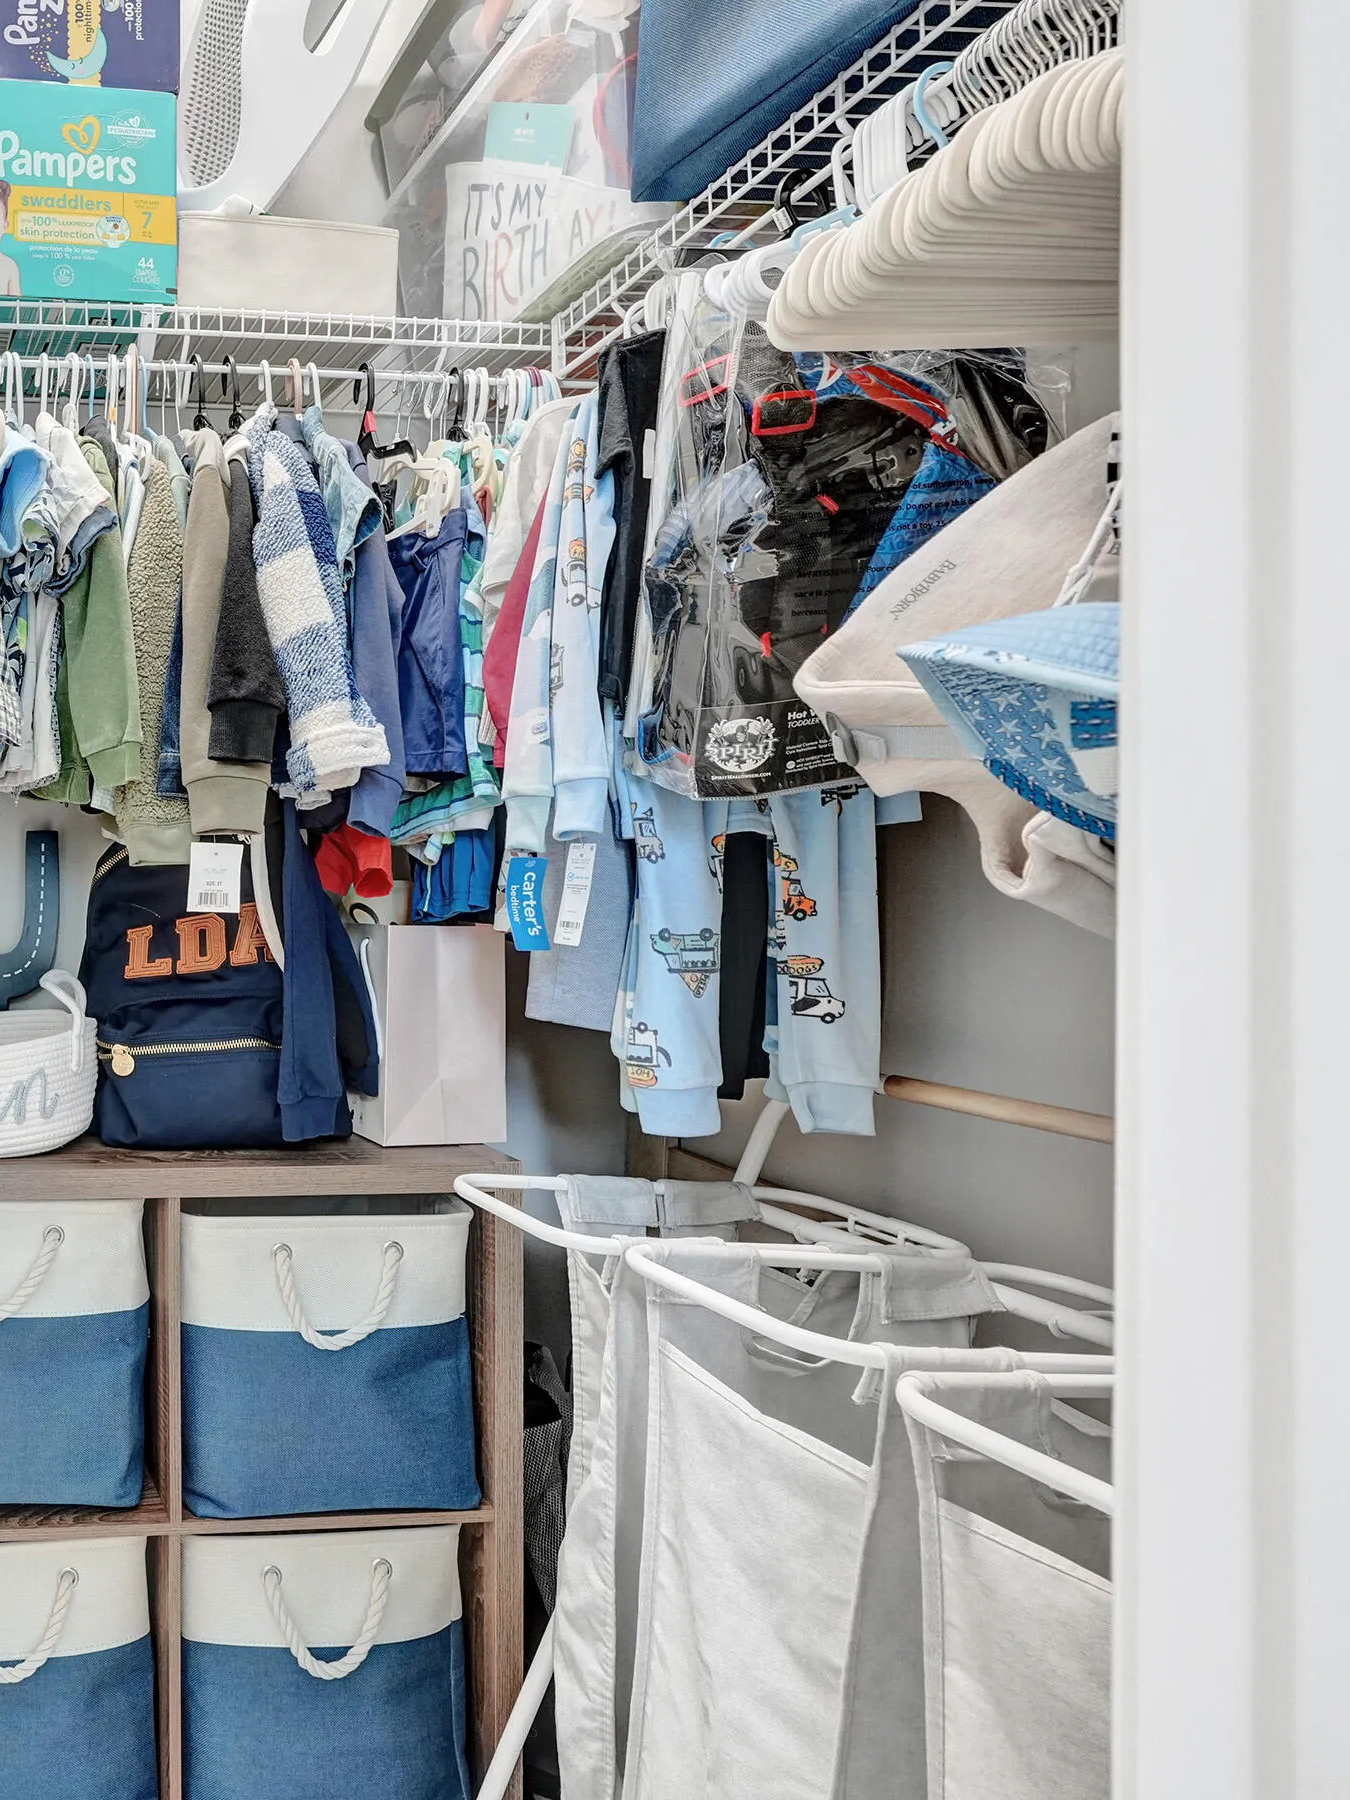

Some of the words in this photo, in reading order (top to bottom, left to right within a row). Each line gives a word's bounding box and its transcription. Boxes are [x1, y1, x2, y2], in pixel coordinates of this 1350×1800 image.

[83, 0, 94, 43] nighttim
[109, 127, 154, 137] PEDIATRICIAN
[22, 194, 112, 212] swaddlers
[464, 182, 505, 241] IT'S
[509, 183, 547, 227] MY
[58, 220, 95, 228] LEAKPROOF
[141, 211, 153, 229] 7
[19, 227, 40, 238] skin
[42, 227, 95, 241] protection
[50, 252, 63, 260] 100
[137, 256, 155, 269] 44
[462, 200, 616, 323] BIRTHAY!
[788, 710, 807, 721] Hot
[704, 738, 779, 760] SPIRIT
[510, 885, 521, 923] bedtime
[522, 871, 543, 937] carter's
